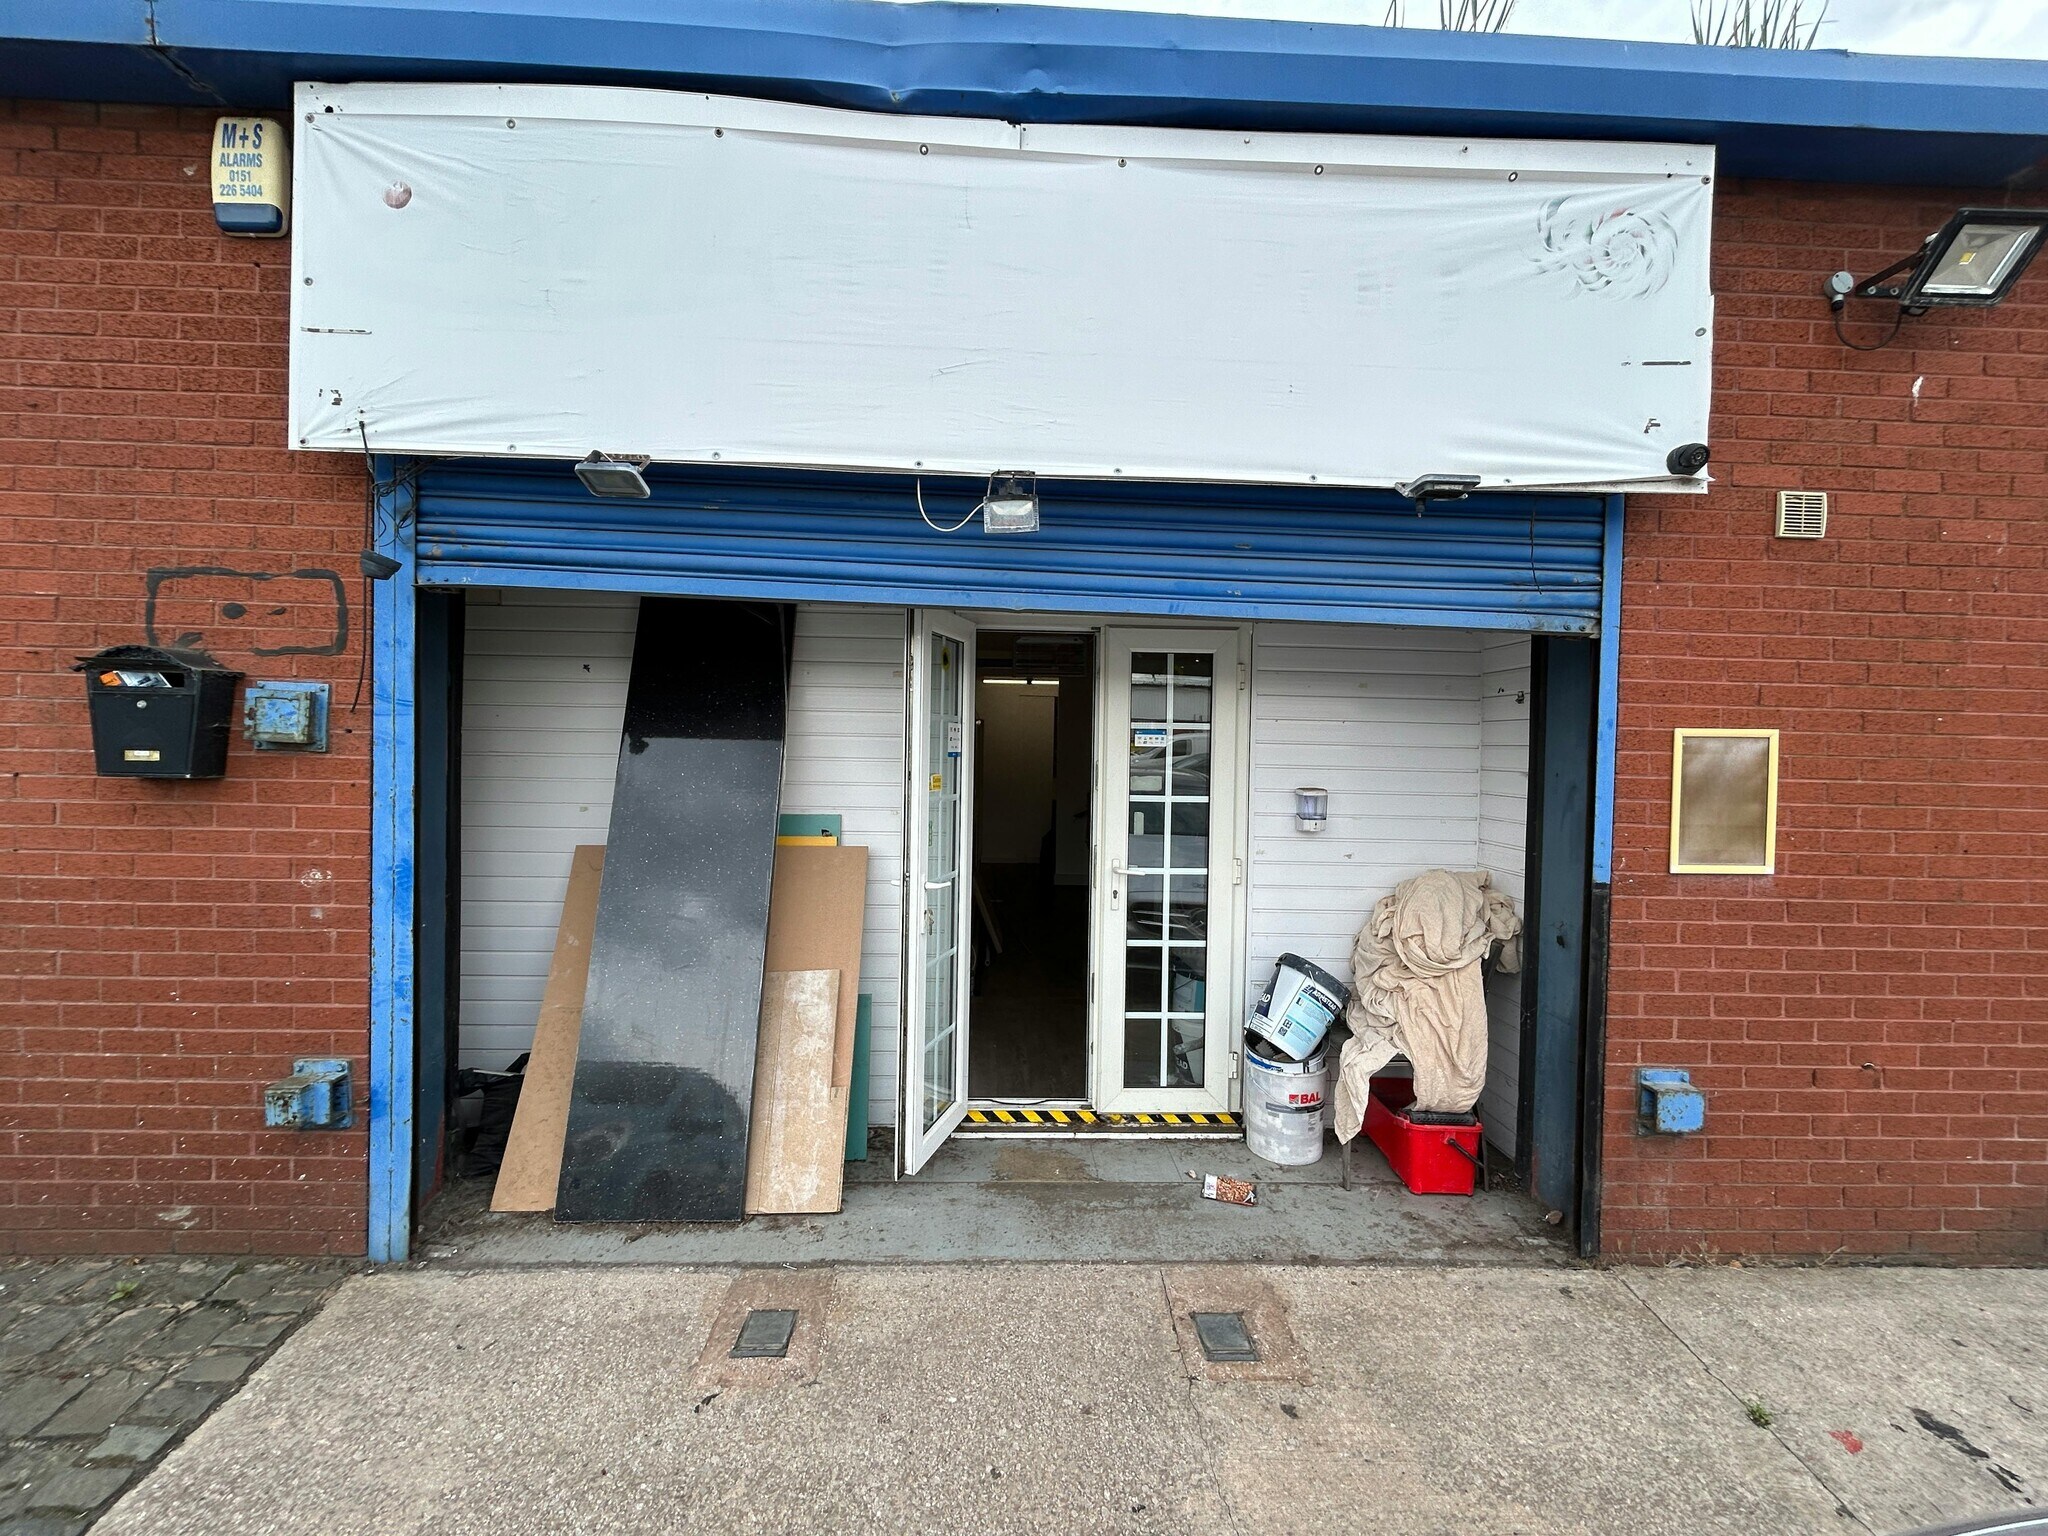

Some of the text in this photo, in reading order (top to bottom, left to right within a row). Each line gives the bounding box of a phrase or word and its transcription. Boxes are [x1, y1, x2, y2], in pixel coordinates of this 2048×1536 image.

[220, 152, 262, 167] ALARMS
[229, 170, 251, 182] 0151
[220, 184, 263, 197] 226 5404
[1300, 1091, 1321, 1104] BAL
